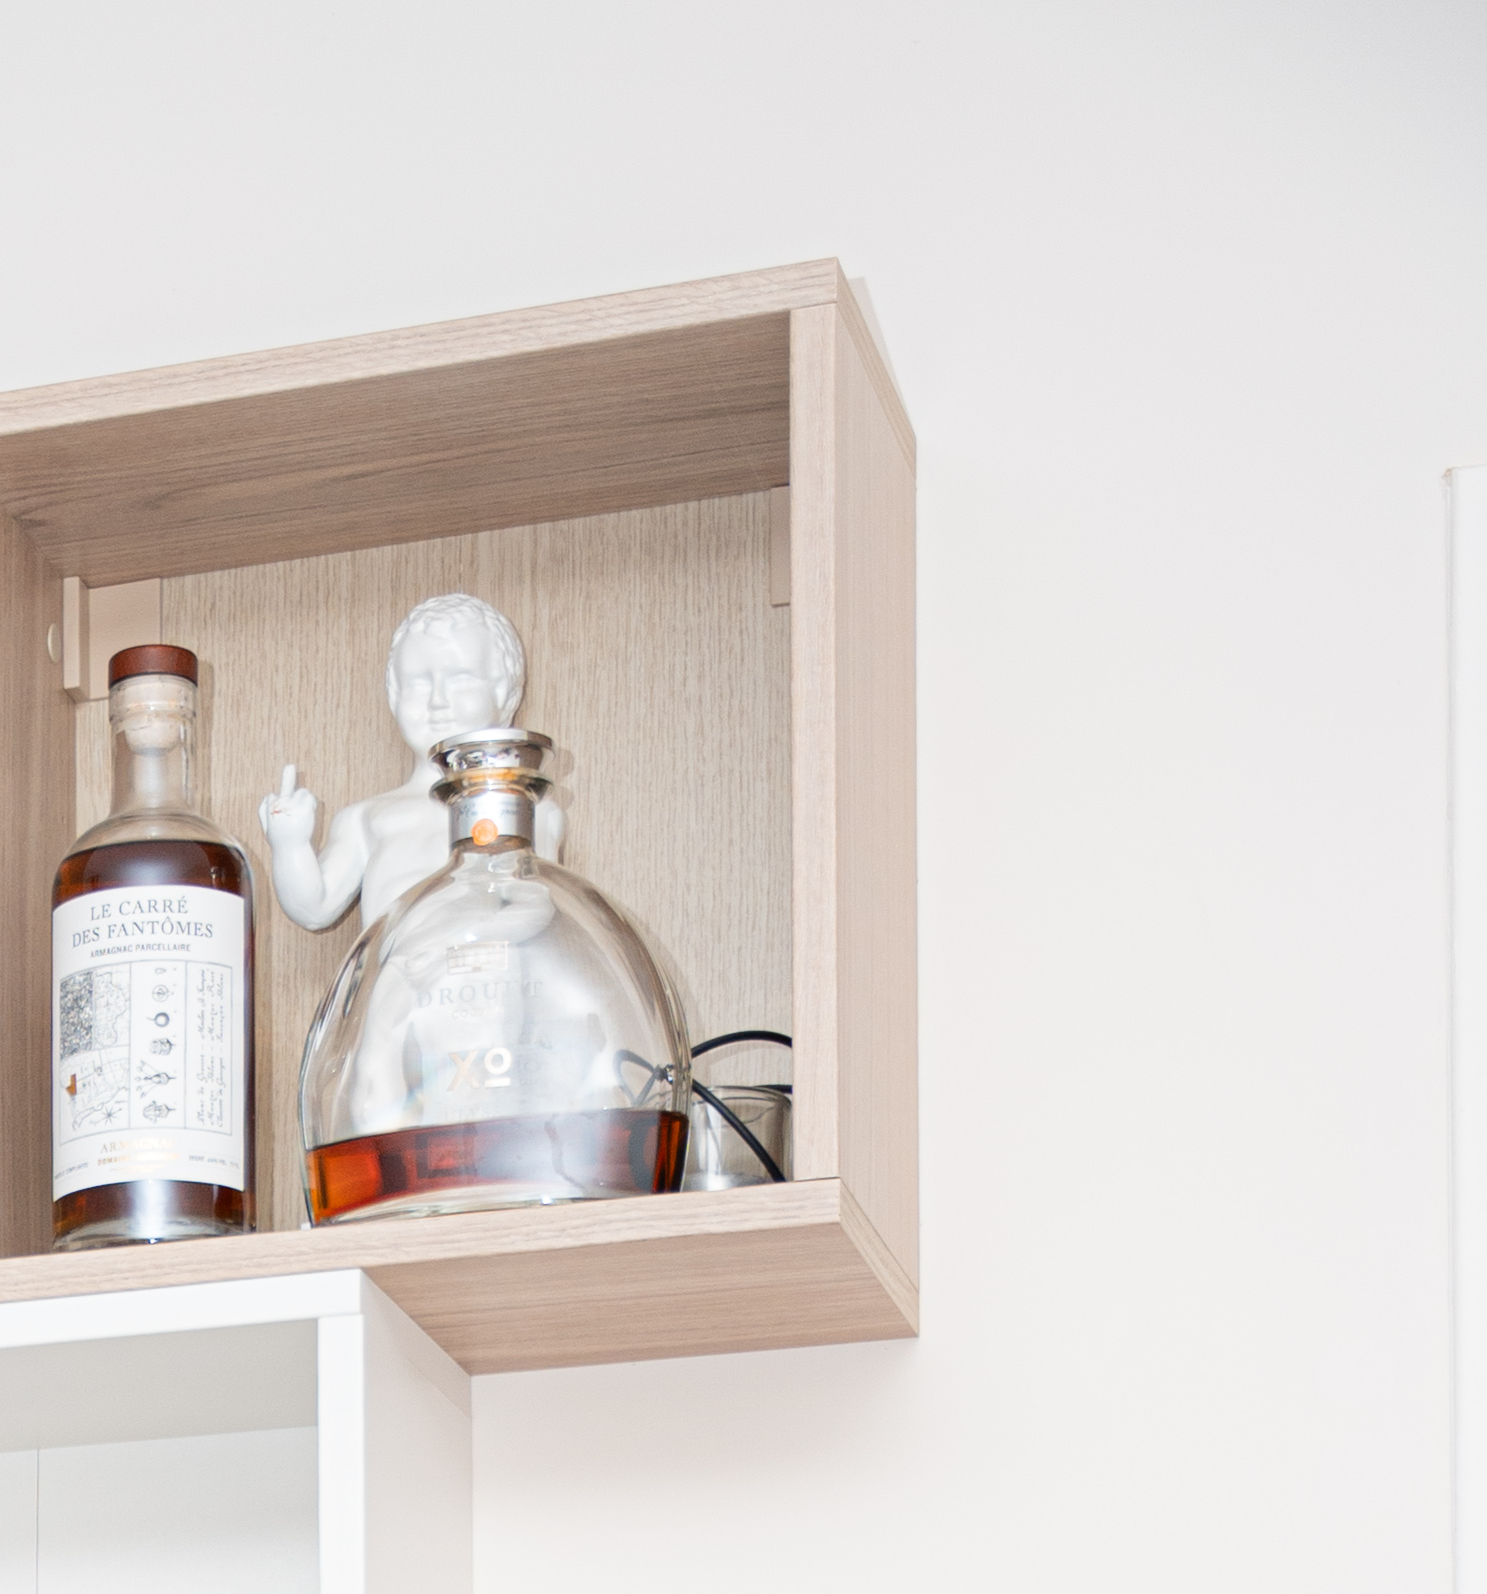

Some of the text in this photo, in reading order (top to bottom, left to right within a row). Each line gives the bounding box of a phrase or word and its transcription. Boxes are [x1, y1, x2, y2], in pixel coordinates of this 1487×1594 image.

[90, 895, 189, 921] LE CARRÉ
[72, 917, 213, 948] DES FANTÔMES
[90, 943, 191, 959] ARMAGNAC PARCELLAIRE
